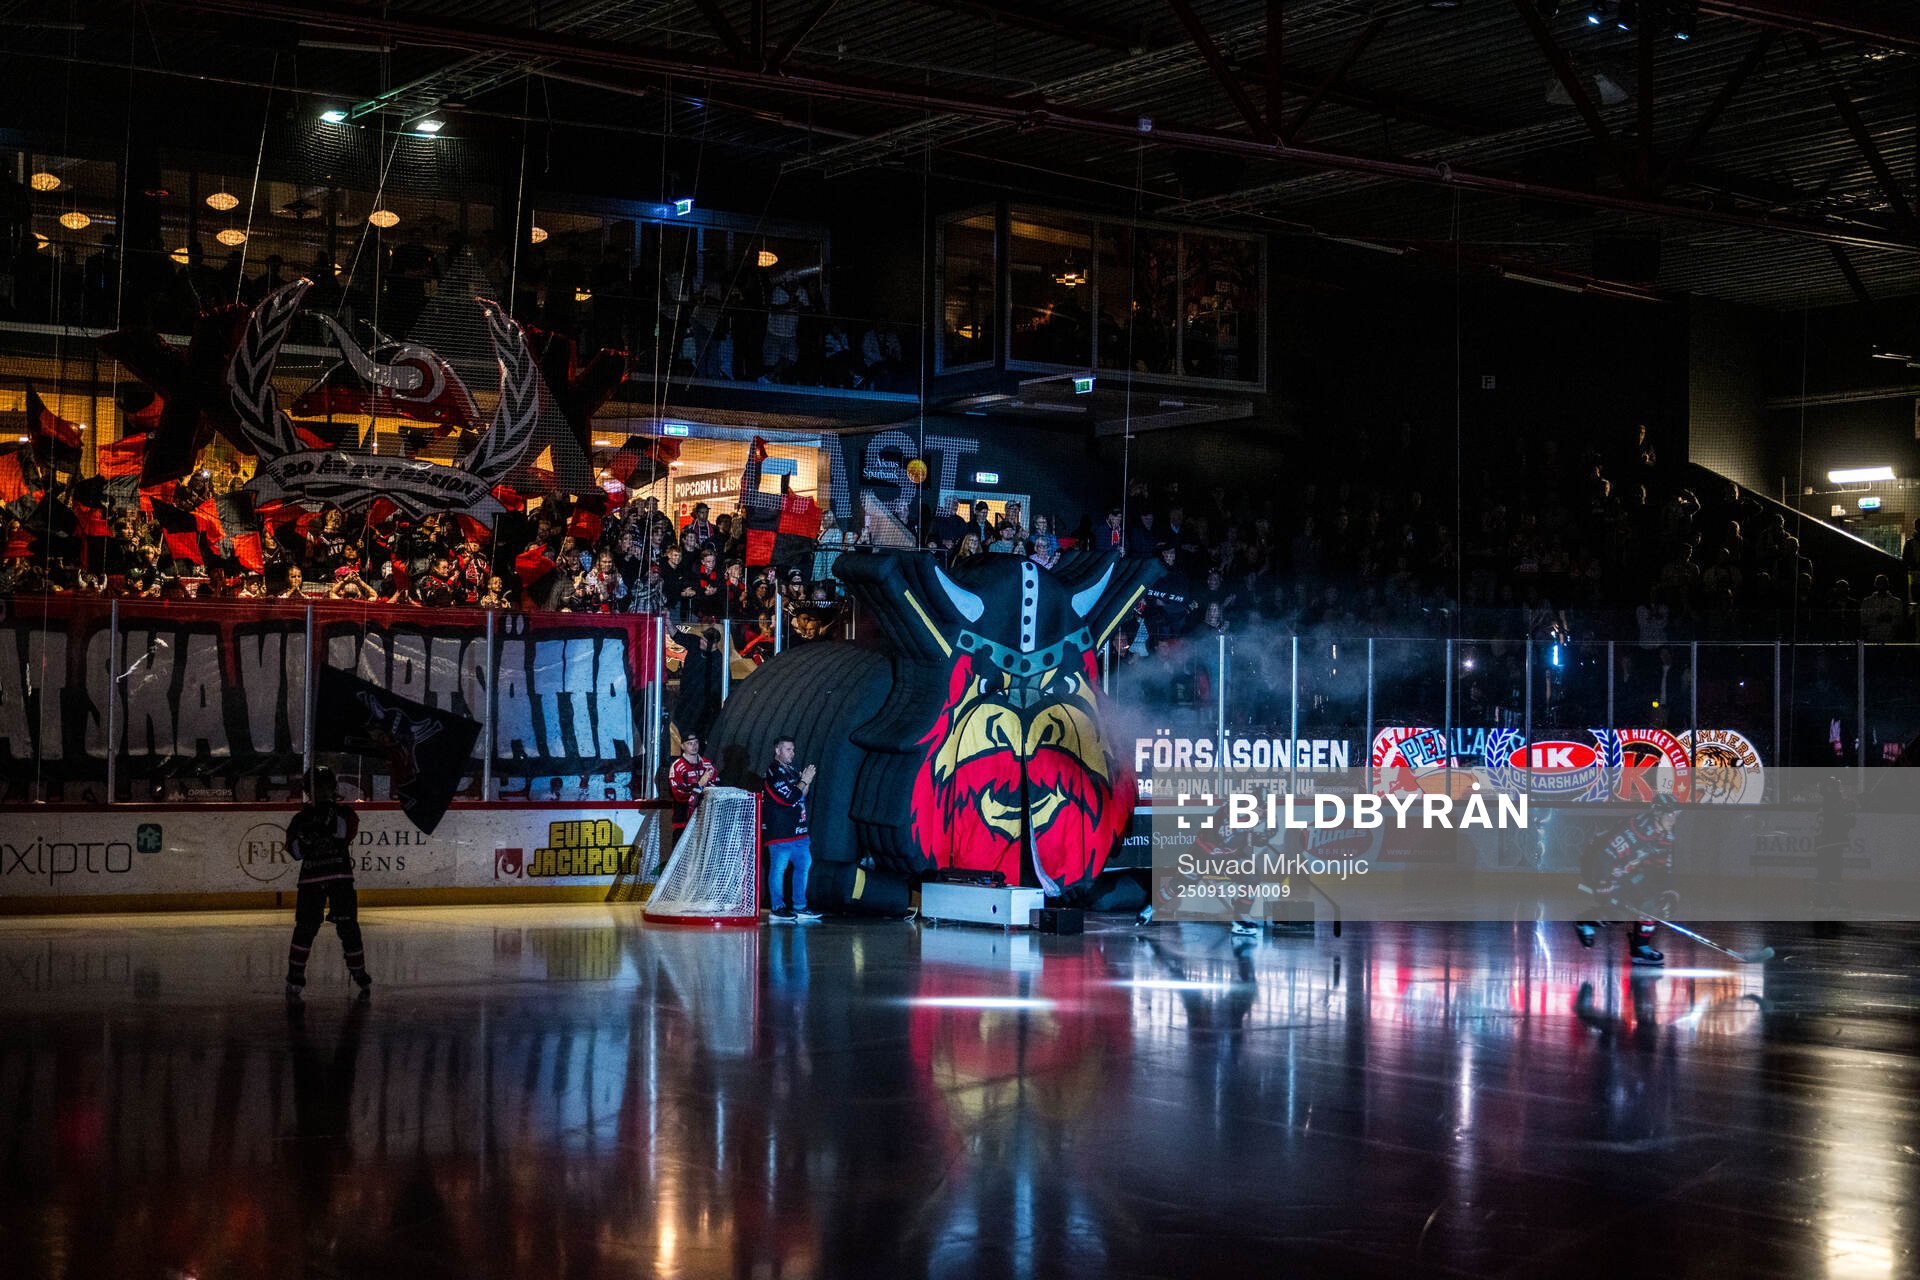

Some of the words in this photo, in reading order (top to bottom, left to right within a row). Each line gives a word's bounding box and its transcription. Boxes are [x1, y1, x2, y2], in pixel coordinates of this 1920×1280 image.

[675, 480, 711, 498] POPCORN
[713, 478, 719, 493] &
[1135, 729, 1349, 773] FÖRSÄSONGEN
[1531, 746, 1576, 767] IK
[1632, 728, 1674, 751] HOCKEY
[1670, 748, 1688, 776] CLUB
[1680, 728, 1761, 775] VMMERBY
[1513, 767, 1596, 789] OSKARSHAMN
[549, 820, 614, 849] EURO
[1122, 833, 1150, 847] lems
[0, 836, 132, 886] xipto
[528, 845, 636, 877] JACKPOT
